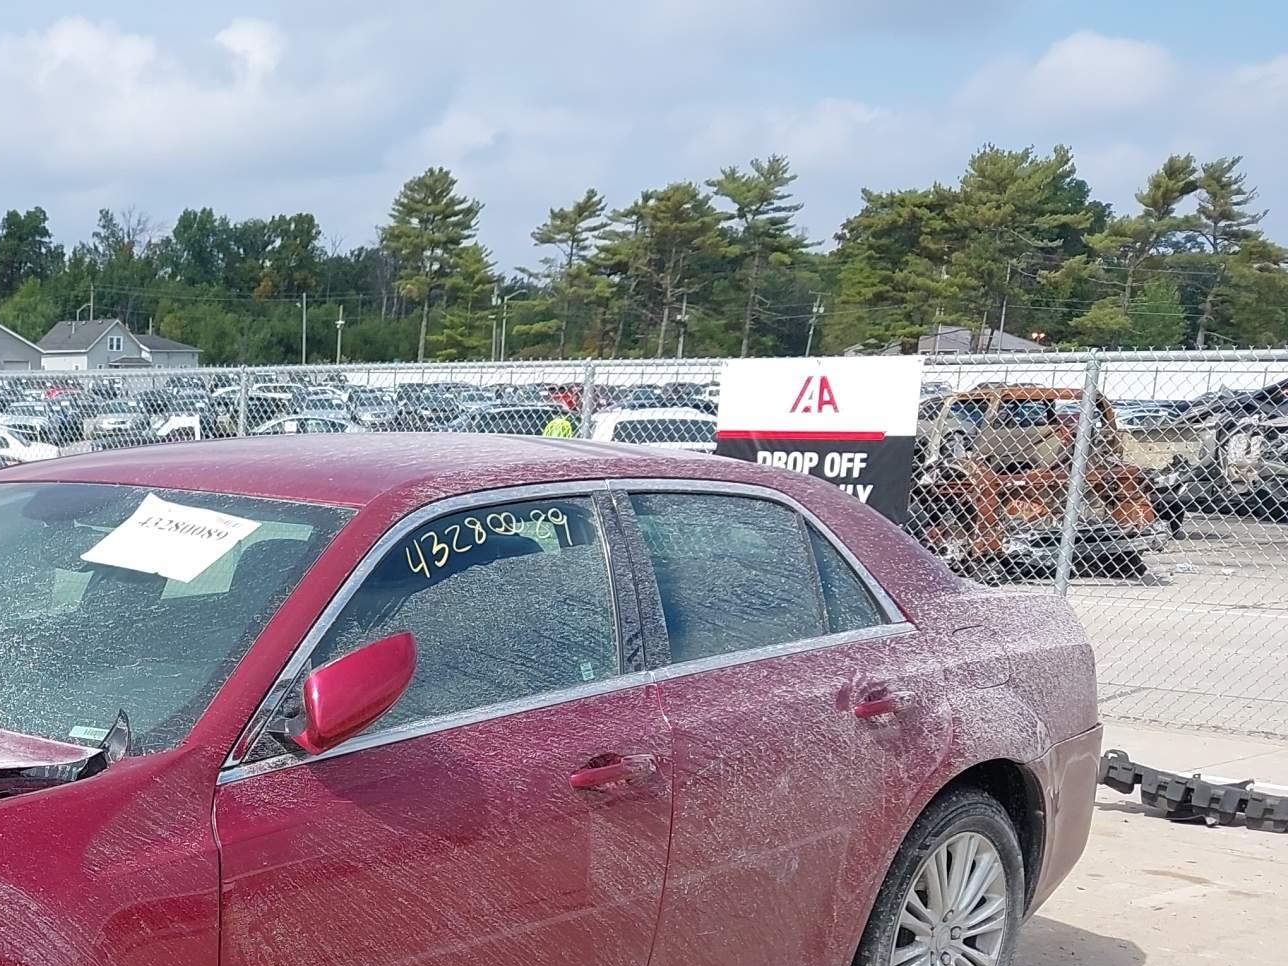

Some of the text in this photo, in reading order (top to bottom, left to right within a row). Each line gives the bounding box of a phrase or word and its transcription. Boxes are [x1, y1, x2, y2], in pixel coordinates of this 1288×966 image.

[757, 451, 868, 478] DROP OFF
[137, 515, 230, 541] 43280089
[405, 508, 574, 579] 43280089
